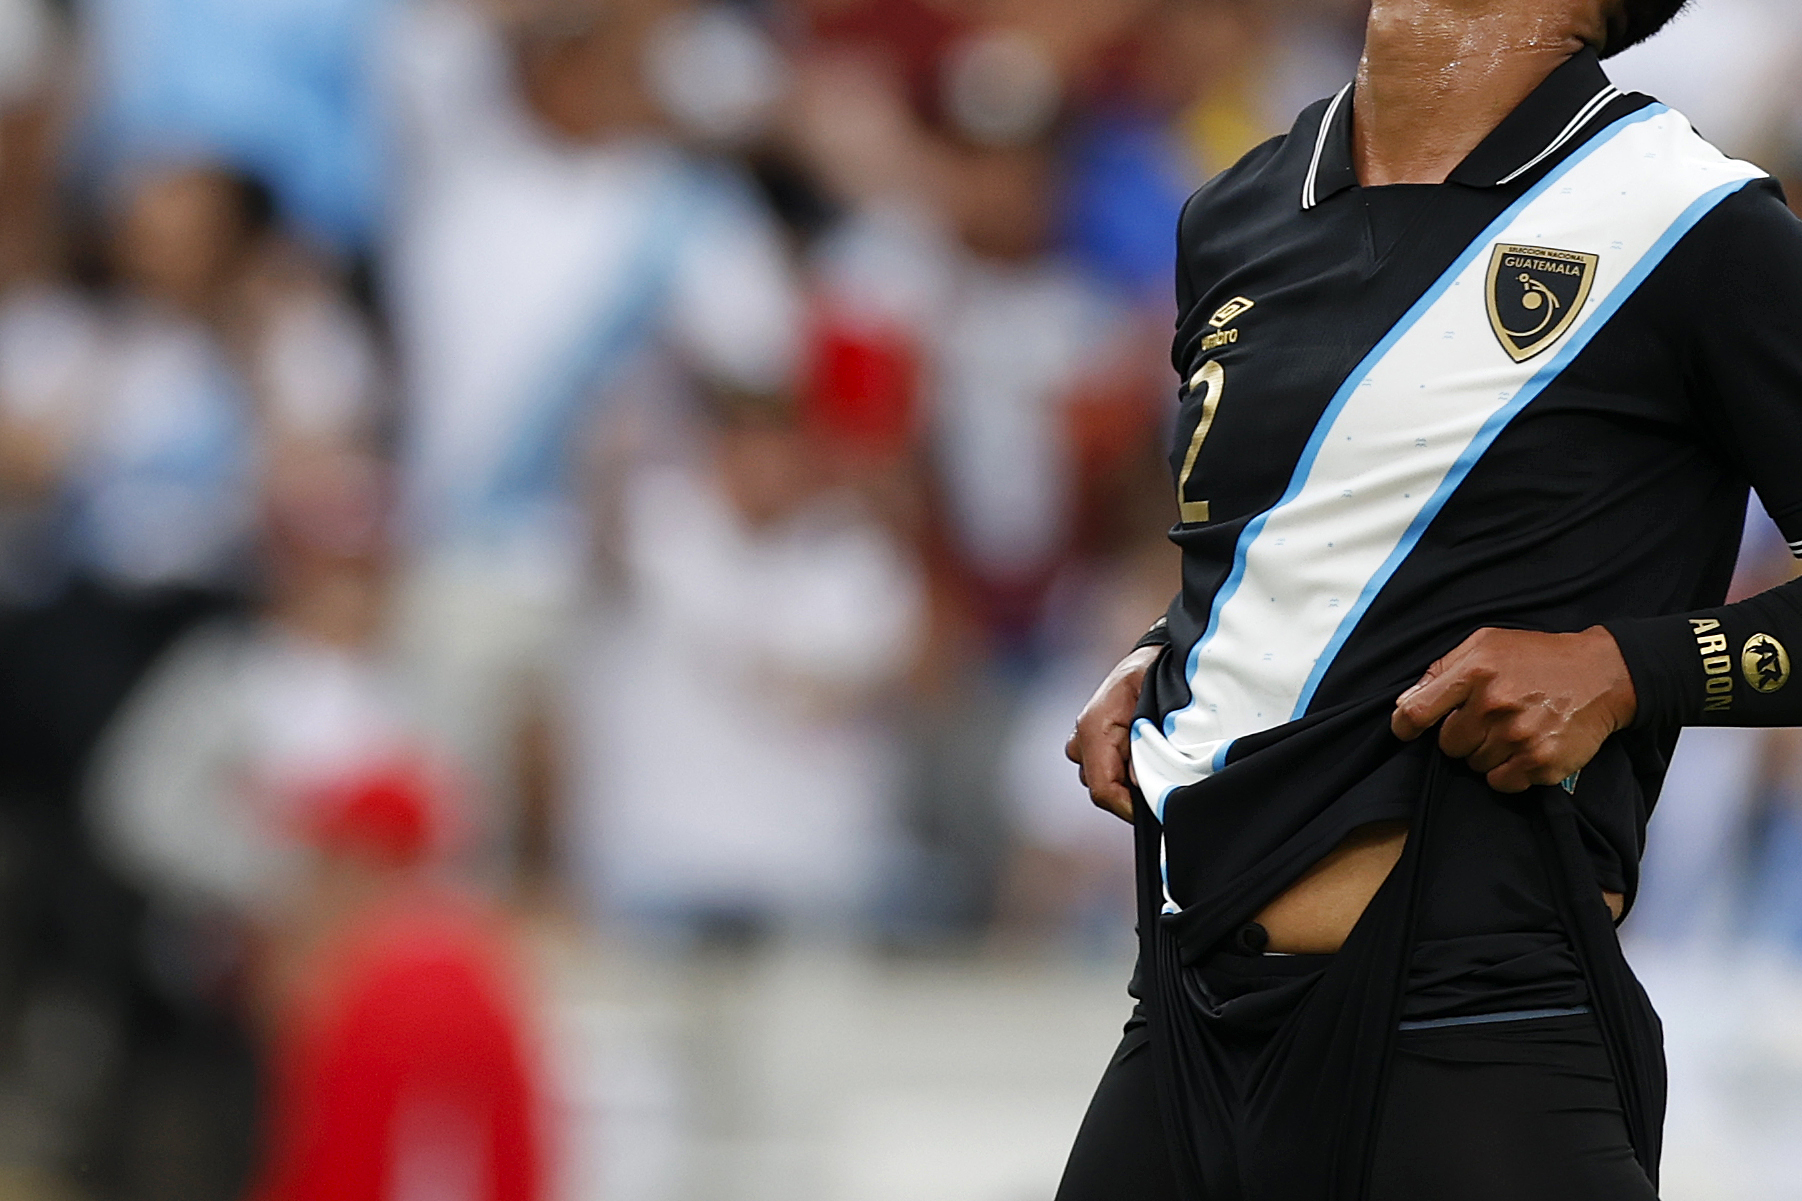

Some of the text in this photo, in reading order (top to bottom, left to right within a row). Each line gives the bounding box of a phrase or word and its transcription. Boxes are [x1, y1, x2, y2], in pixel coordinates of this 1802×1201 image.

[1504, 256, 1581, 277] GUATEMALA
[1547, 251, 1584, 262] NACIONAL
[1177, 360, 1224, 523] 2
[1688, 619, 1733, 712] ARDON
